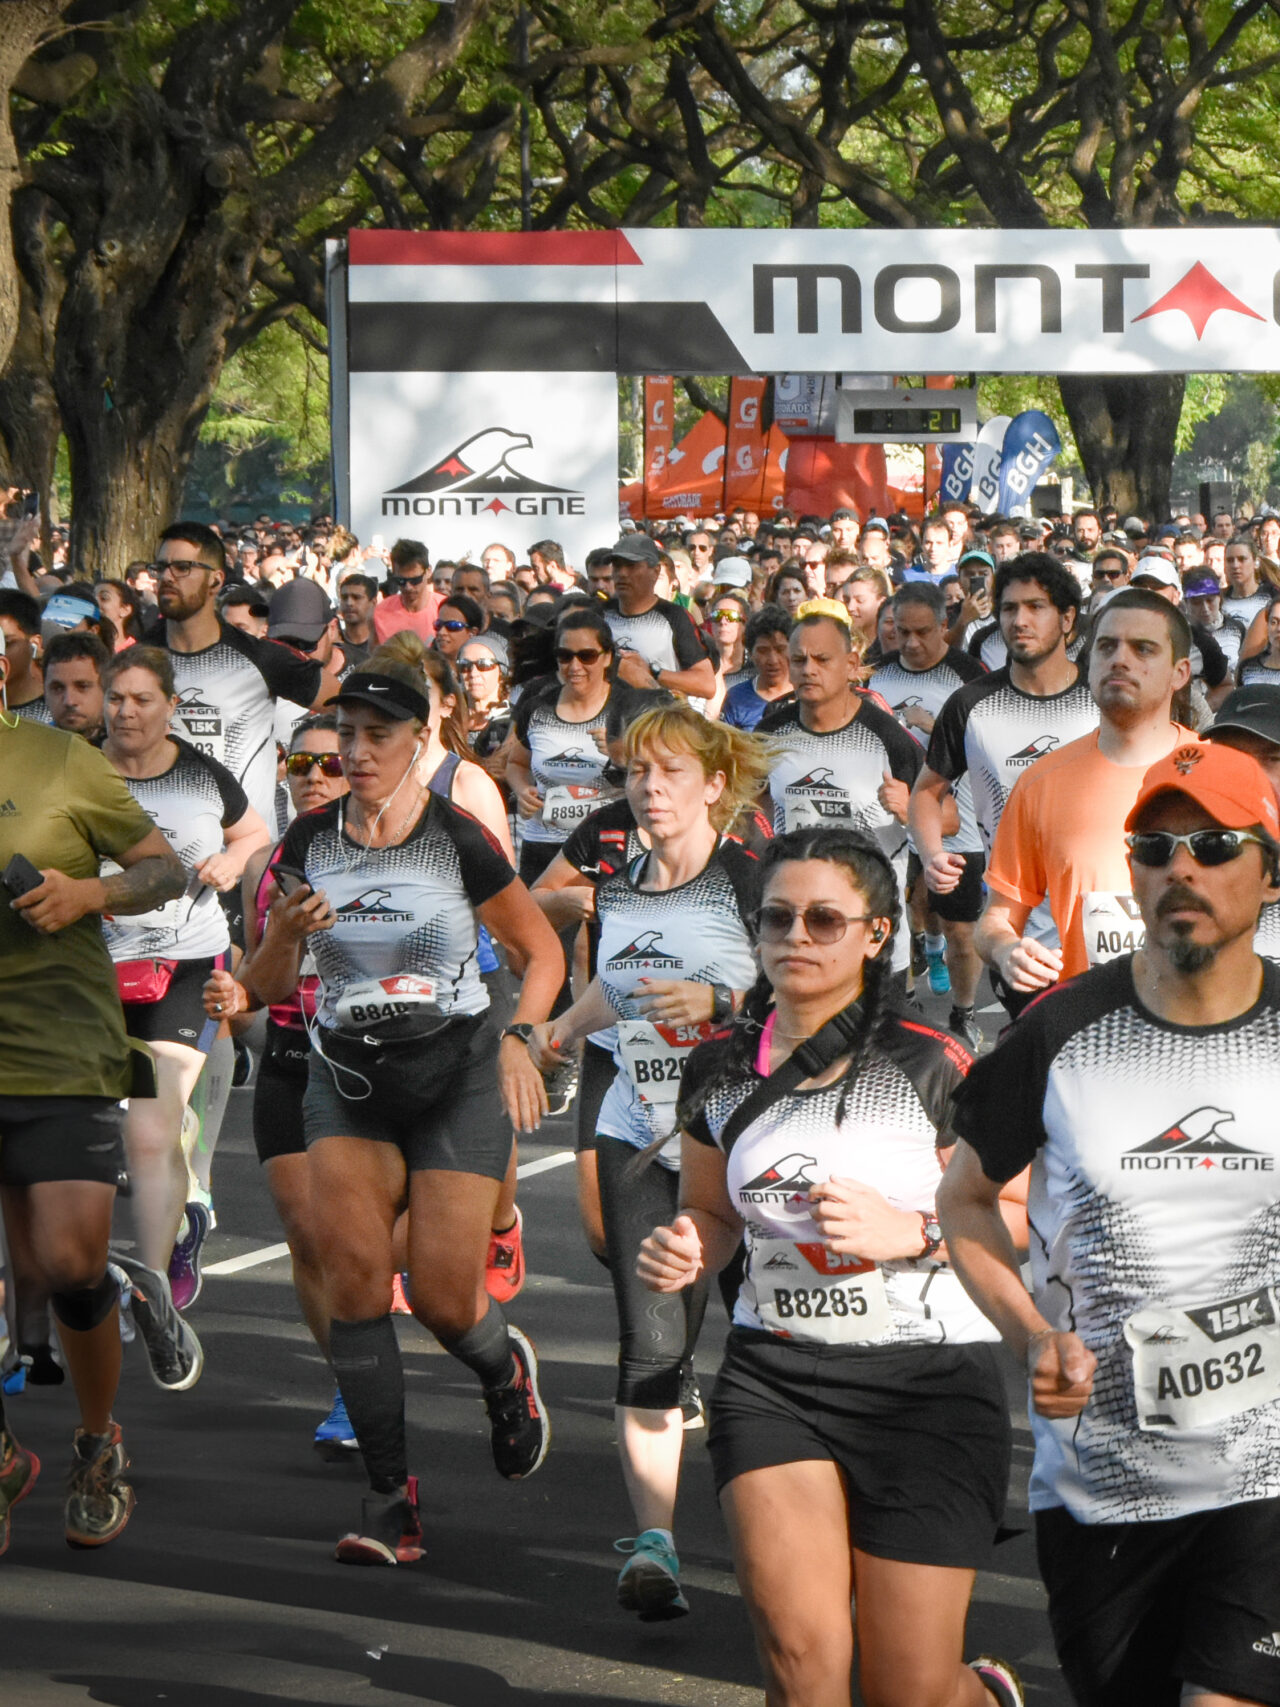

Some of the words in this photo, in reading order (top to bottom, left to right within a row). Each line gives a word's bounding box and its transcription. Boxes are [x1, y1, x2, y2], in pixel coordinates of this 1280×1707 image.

[1006, 432, 1053, 496] BGH
[381, 496, 585, 516] MONTAGNE
[190, 721, 216, 733] 15K
[578, 787, 594, 796] 5K
[552, 804, 592, 820] B8937
[819, 802, 846, 815] 15K
[337, 912, 415, 923] ONTAGNE
[675, 1025, 705, 1042] 5K
[634, 1057, 688, 1084] B82
[1121, 1155, 1275, 1172] MONTAGNE
[774, 1286, 868, 1318] B8285
[1207, 1298, 1265, 1335] 15K
[1158, 1343, 1265, 1400] A0632
